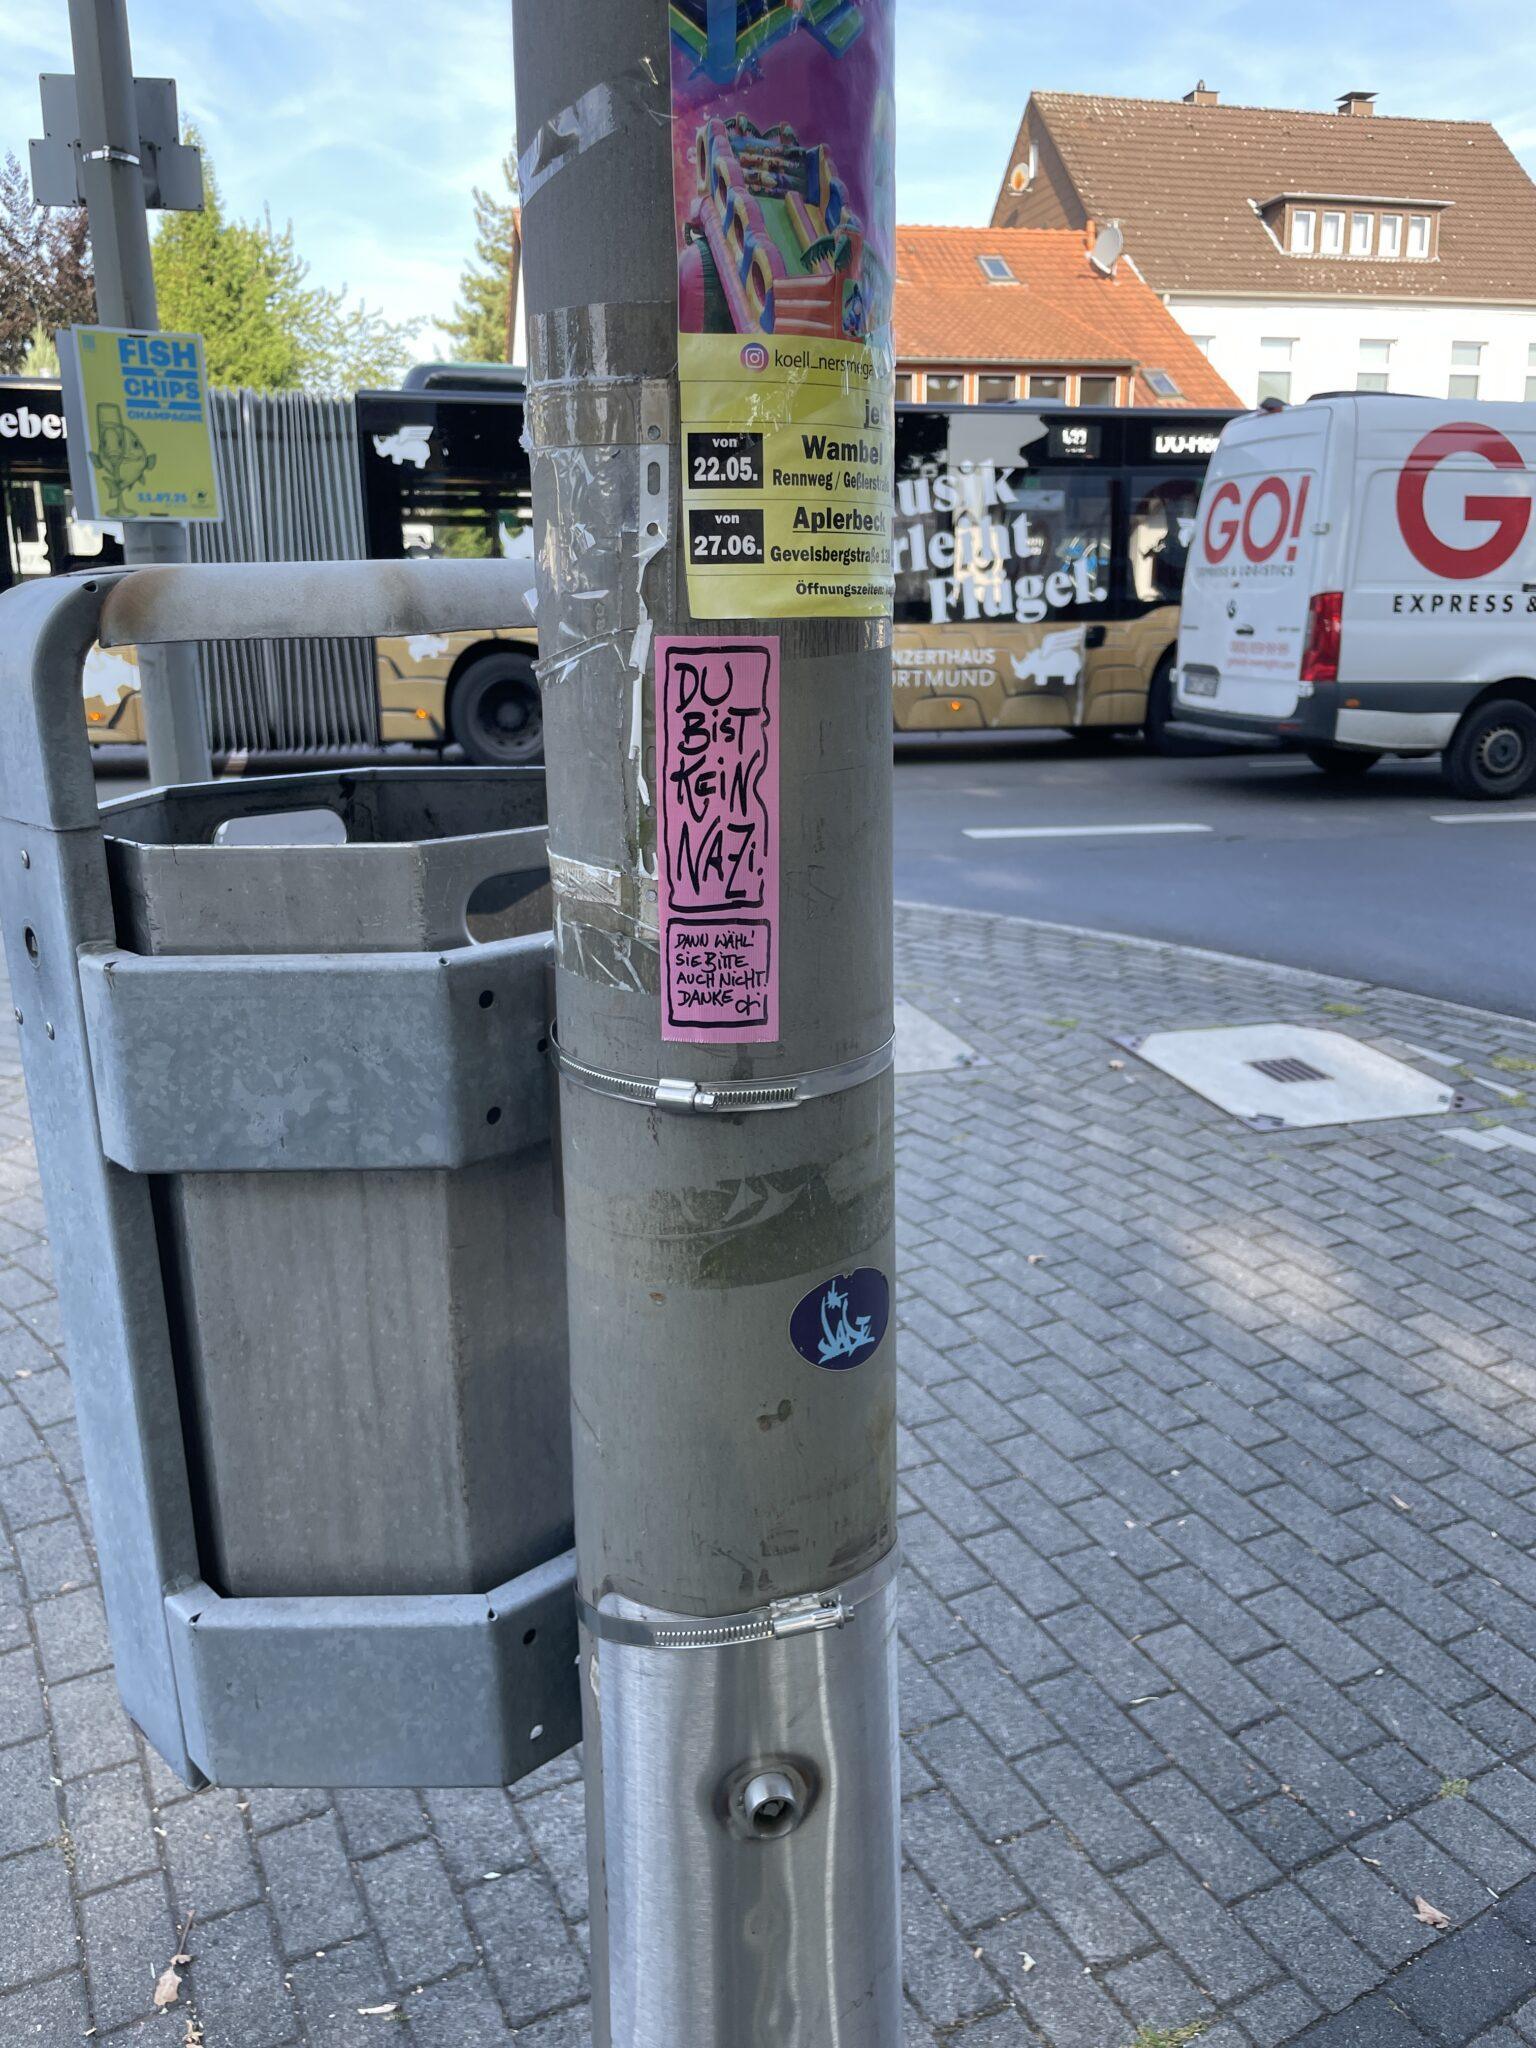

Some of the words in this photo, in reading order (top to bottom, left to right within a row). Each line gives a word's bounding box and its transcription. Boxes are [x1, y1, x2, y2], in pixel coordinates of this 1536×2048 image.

[118, 338, 198, 369] FISH
[123, 378, 200, 400] CHIPS
[712, 438, 738, 448] von
[801, 434, 883, 465] Wambel
[694, 457, 758, 481] 22.05.
[773, 468, 833, 491] Rennweg
[835, 471, 841, 490] /
[715, 515, 740, 524] von
[792, 506, 886, 534] Aplerbeck
[1204, 476, 1311, 564] GO!
[694, 535, 763, 556] 27.06.
[770, 545, 879, 566] Gevelsbergstraße
[1393, 594, 1514, 613] EXPRESS
[674, 661, 734, 714] DU
[674, 932, 709, 950] DANN
[676, 971, 715, 989] AUCH
[677, 988, 734, 1008] DANKE
